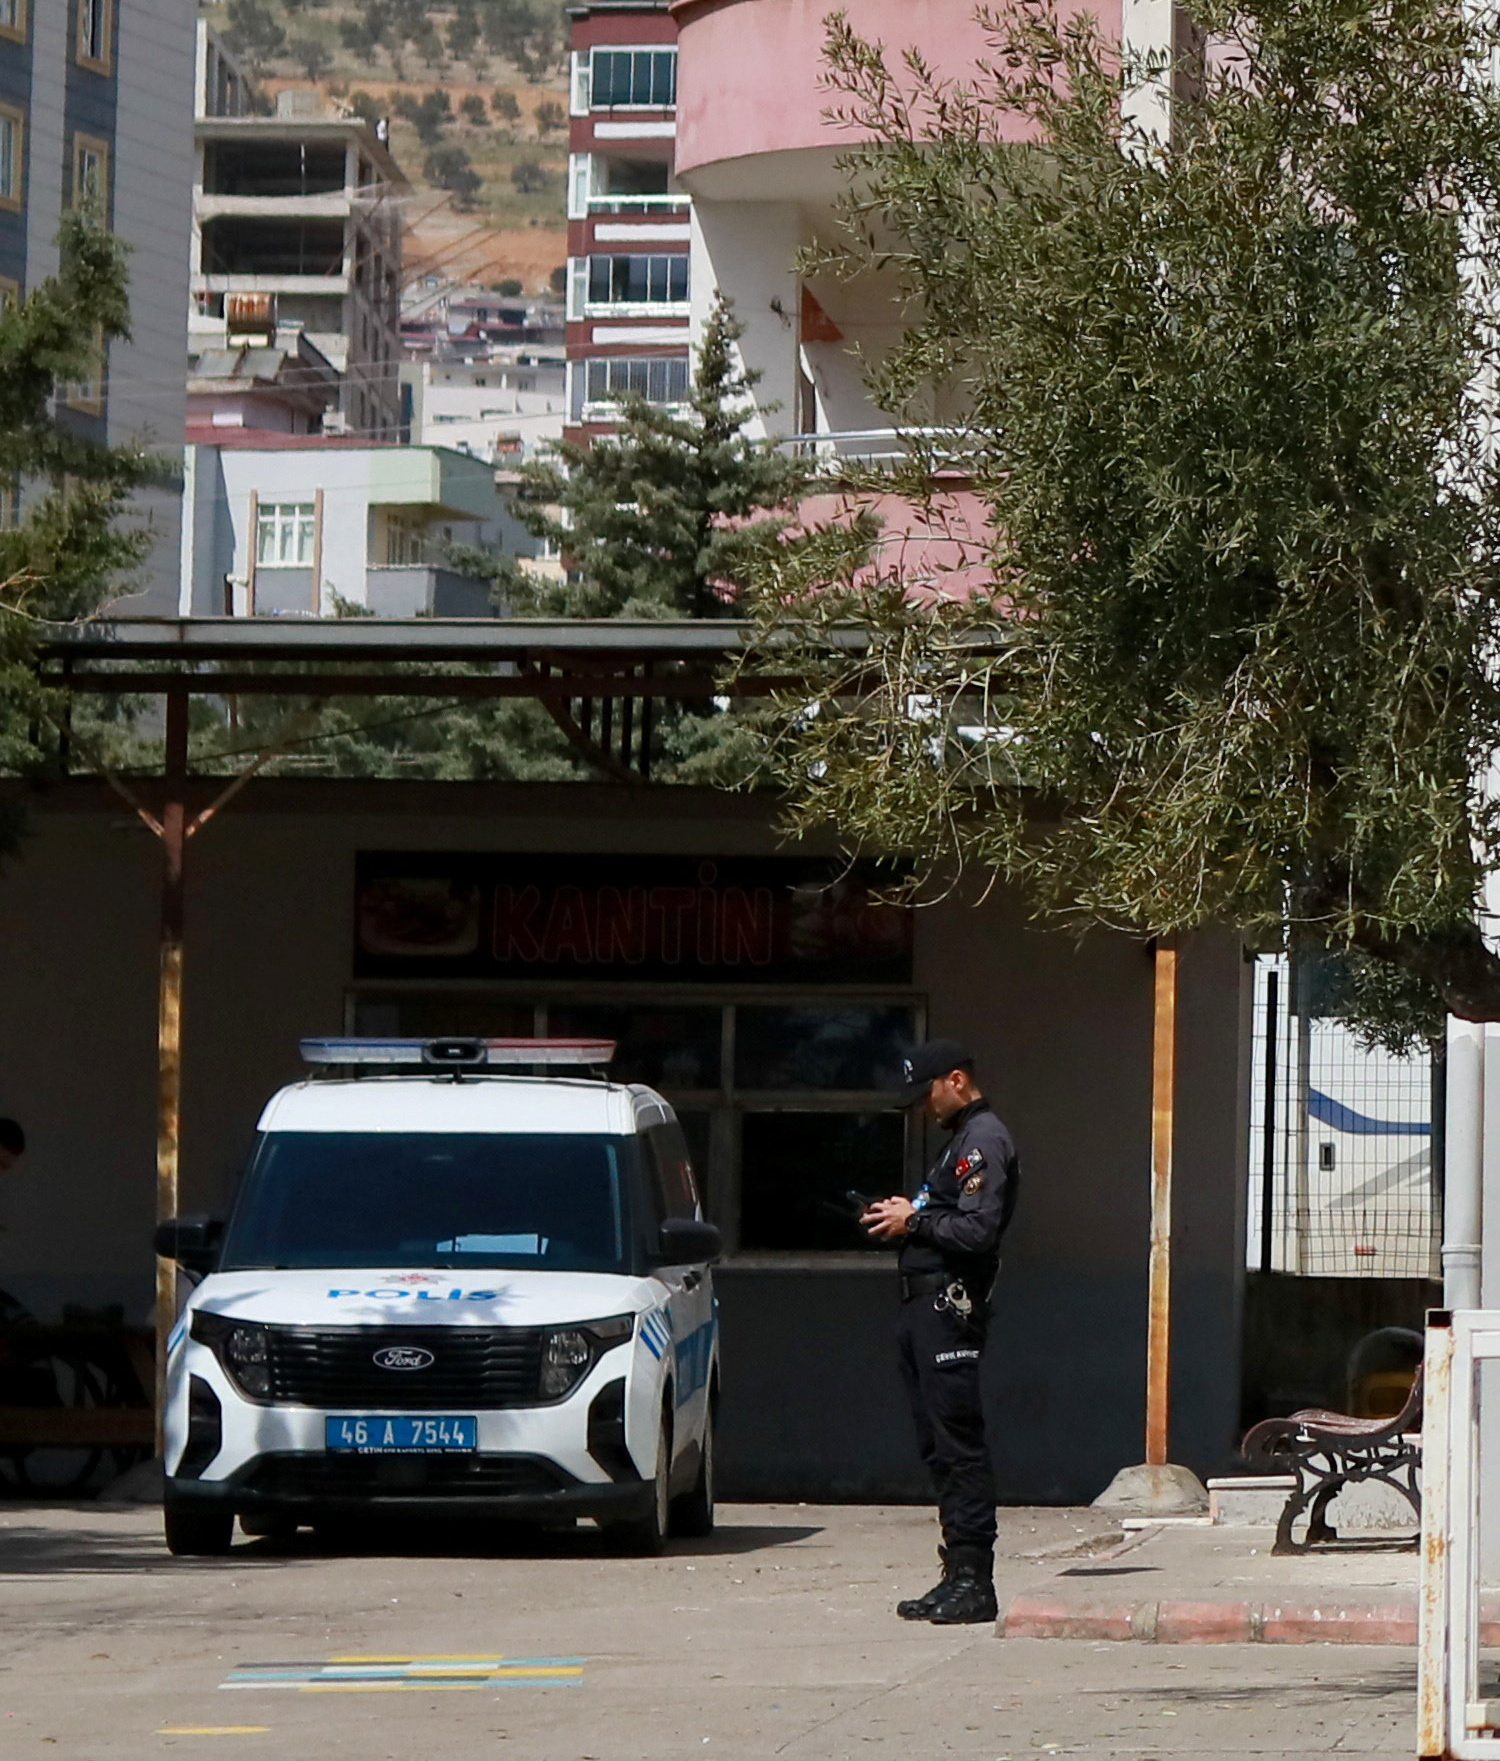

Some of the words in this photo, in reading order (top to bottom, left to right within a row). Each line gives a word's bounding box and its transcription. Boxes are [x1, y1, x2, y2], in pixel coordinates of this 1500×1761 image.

[491, 861, 775, 966] KANTİN
[326, 1288, 498, 1302] POLİS
[383, 1349, 424, 1367] Ford
[340, 1420, 369, 1445] 46
[382, 1420, 395, 1445] A
[411, 1420, 465, 1446] 7544
